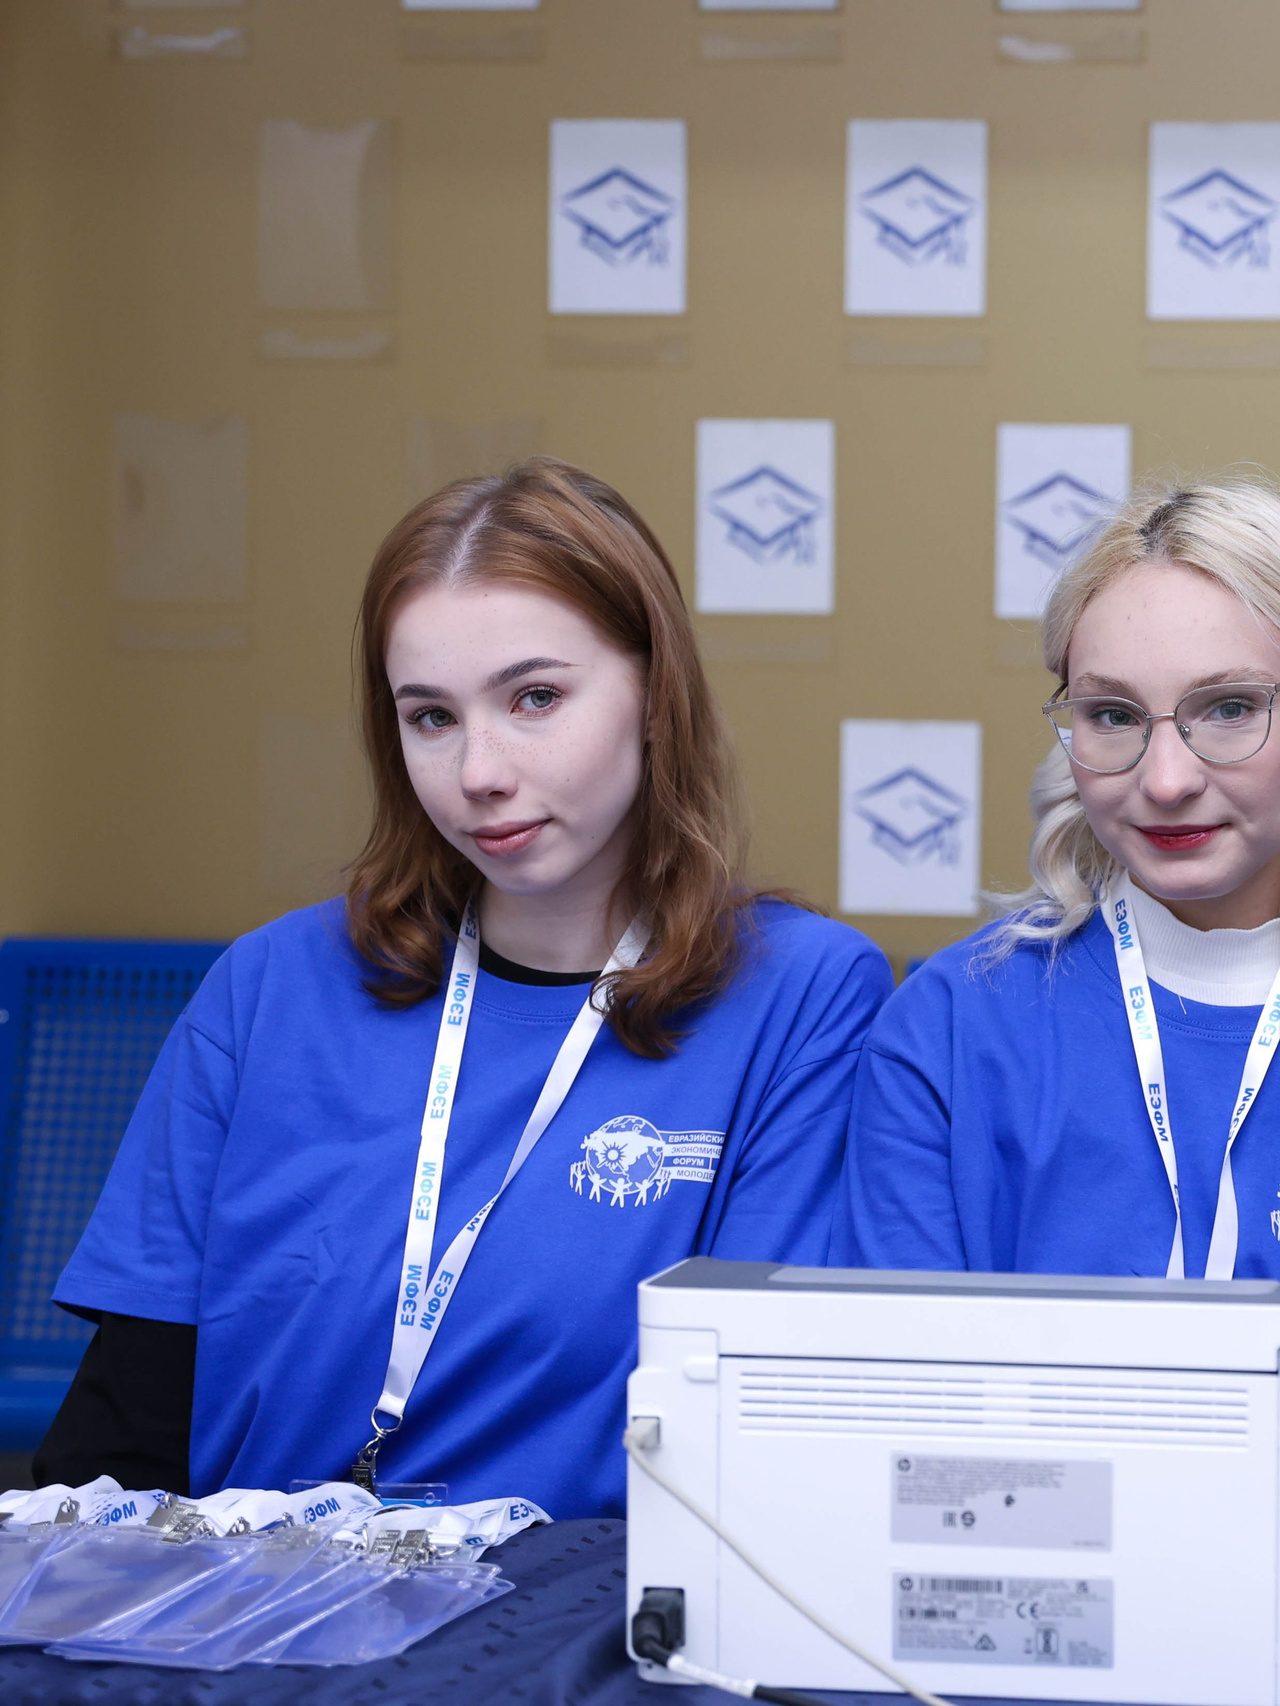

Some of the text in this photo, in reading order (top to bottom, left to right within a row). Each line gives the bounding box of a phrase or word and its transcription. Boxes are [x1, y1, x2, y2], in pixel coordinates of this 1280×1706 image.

[1115, 899, 1133, 950] ЕЭФМ
[447, 973, 471, 1026] ЕЭФМ
[1129, 986, 1153, 1040] ЕЭФМ
[430, 1064, 453, 1119] ЕЭФМ
[1148, 1083, 1168, 1142] ЕЭФМ
[672, 1157, 705, 1167] ФОРУМ
[415, 1161, 437, 1220] ЕЭФМ
[400, 1264, 423, 1326] ЕЭФМ
[420, 1270, 454, 1331] ЕЭФМ
